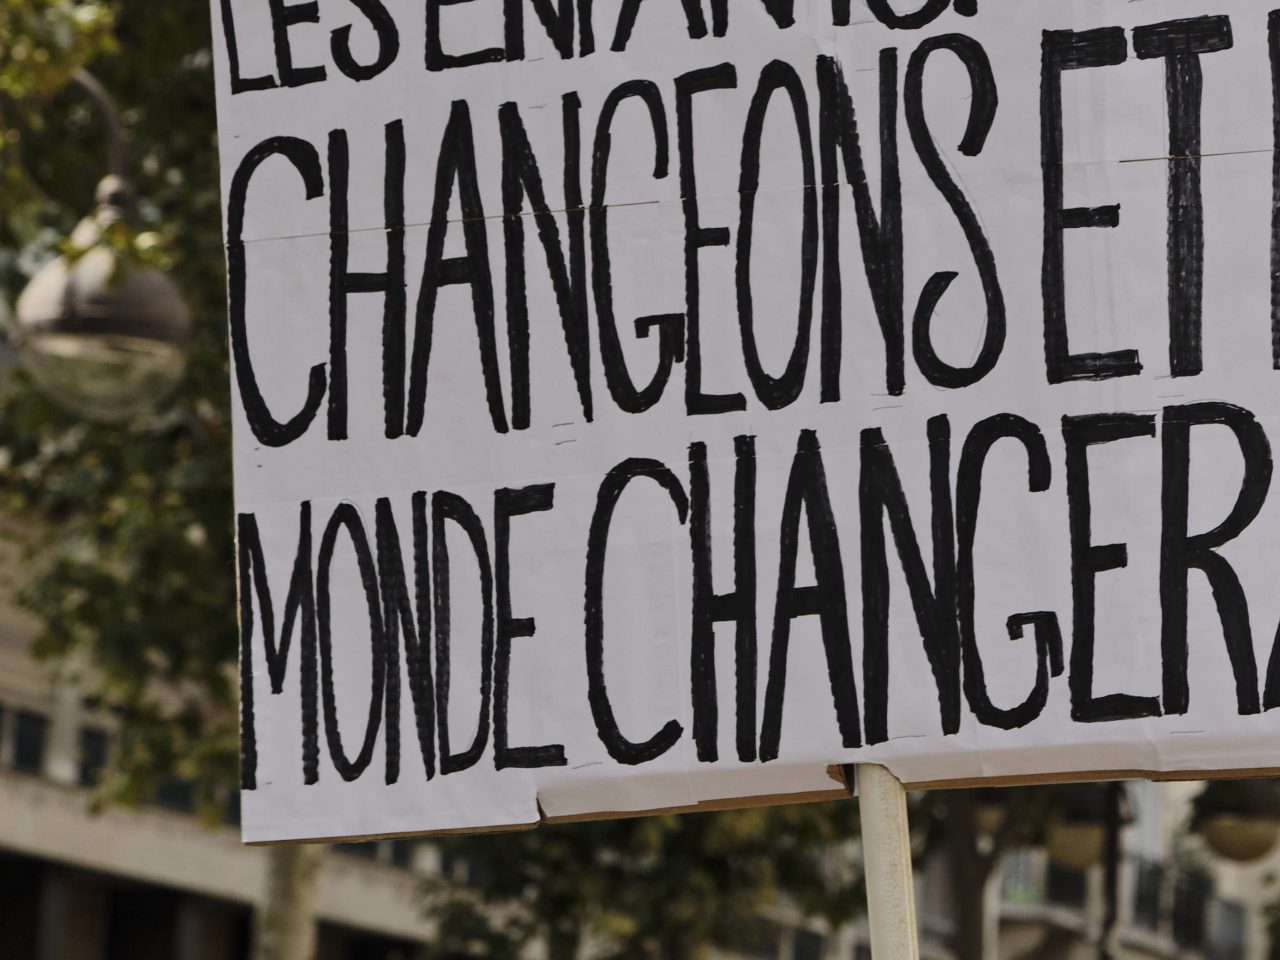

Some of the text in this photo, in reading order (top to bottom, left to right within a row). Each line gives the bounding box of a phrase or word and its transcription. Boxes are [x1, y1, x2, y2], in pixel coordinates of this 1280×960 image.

[225, 33, 1006, 447] CHANGEONS
[1040, 14, 1234, 385] ET
[237, 482, 568, 790] MONDE
